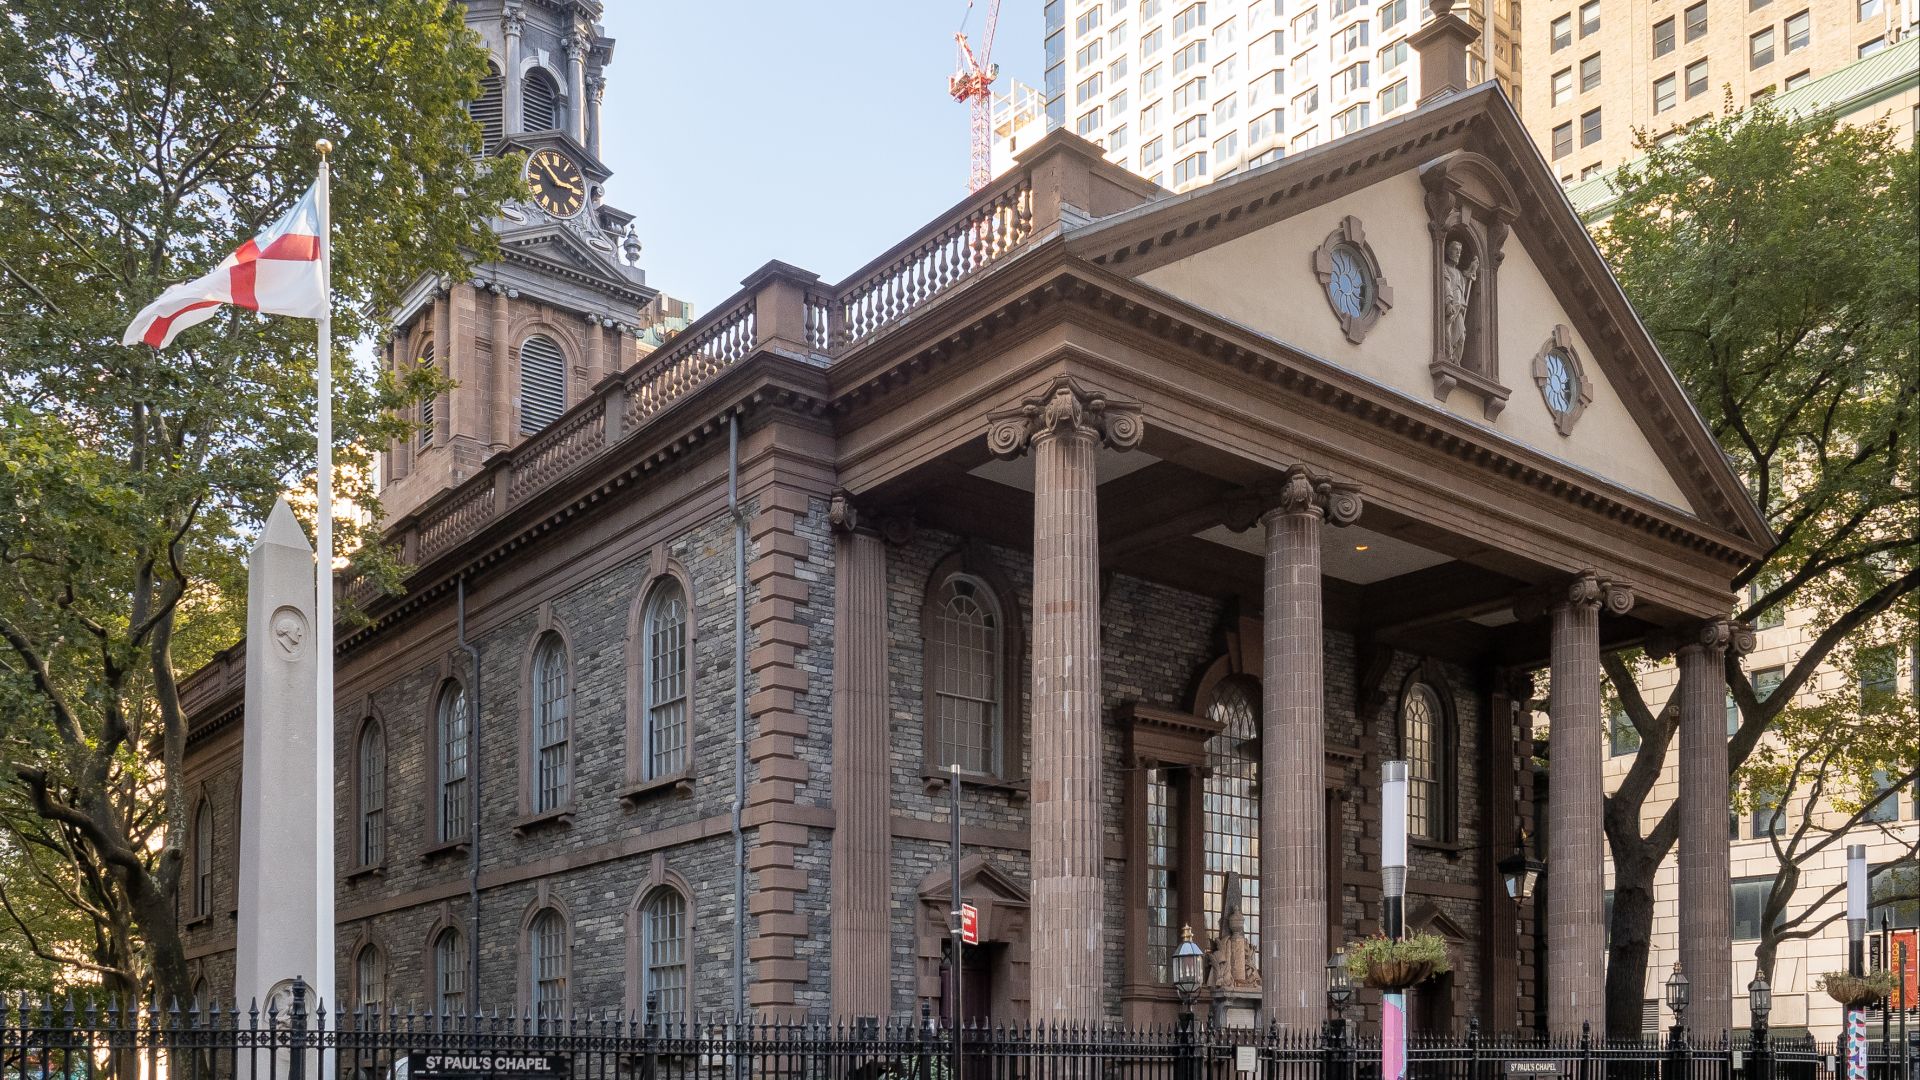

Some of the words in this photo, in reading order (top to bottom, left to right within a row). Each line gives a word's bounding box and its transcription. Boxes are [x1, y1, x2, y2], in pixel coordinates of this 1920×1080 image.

[1892, 942, 1900, 967] CORE
[444, 1056, 491, 1070] PAUL'S
[494, 1057, 551, 1071] CHAPEL
[1535, 1063, 1556, 1071] CHAPEL
